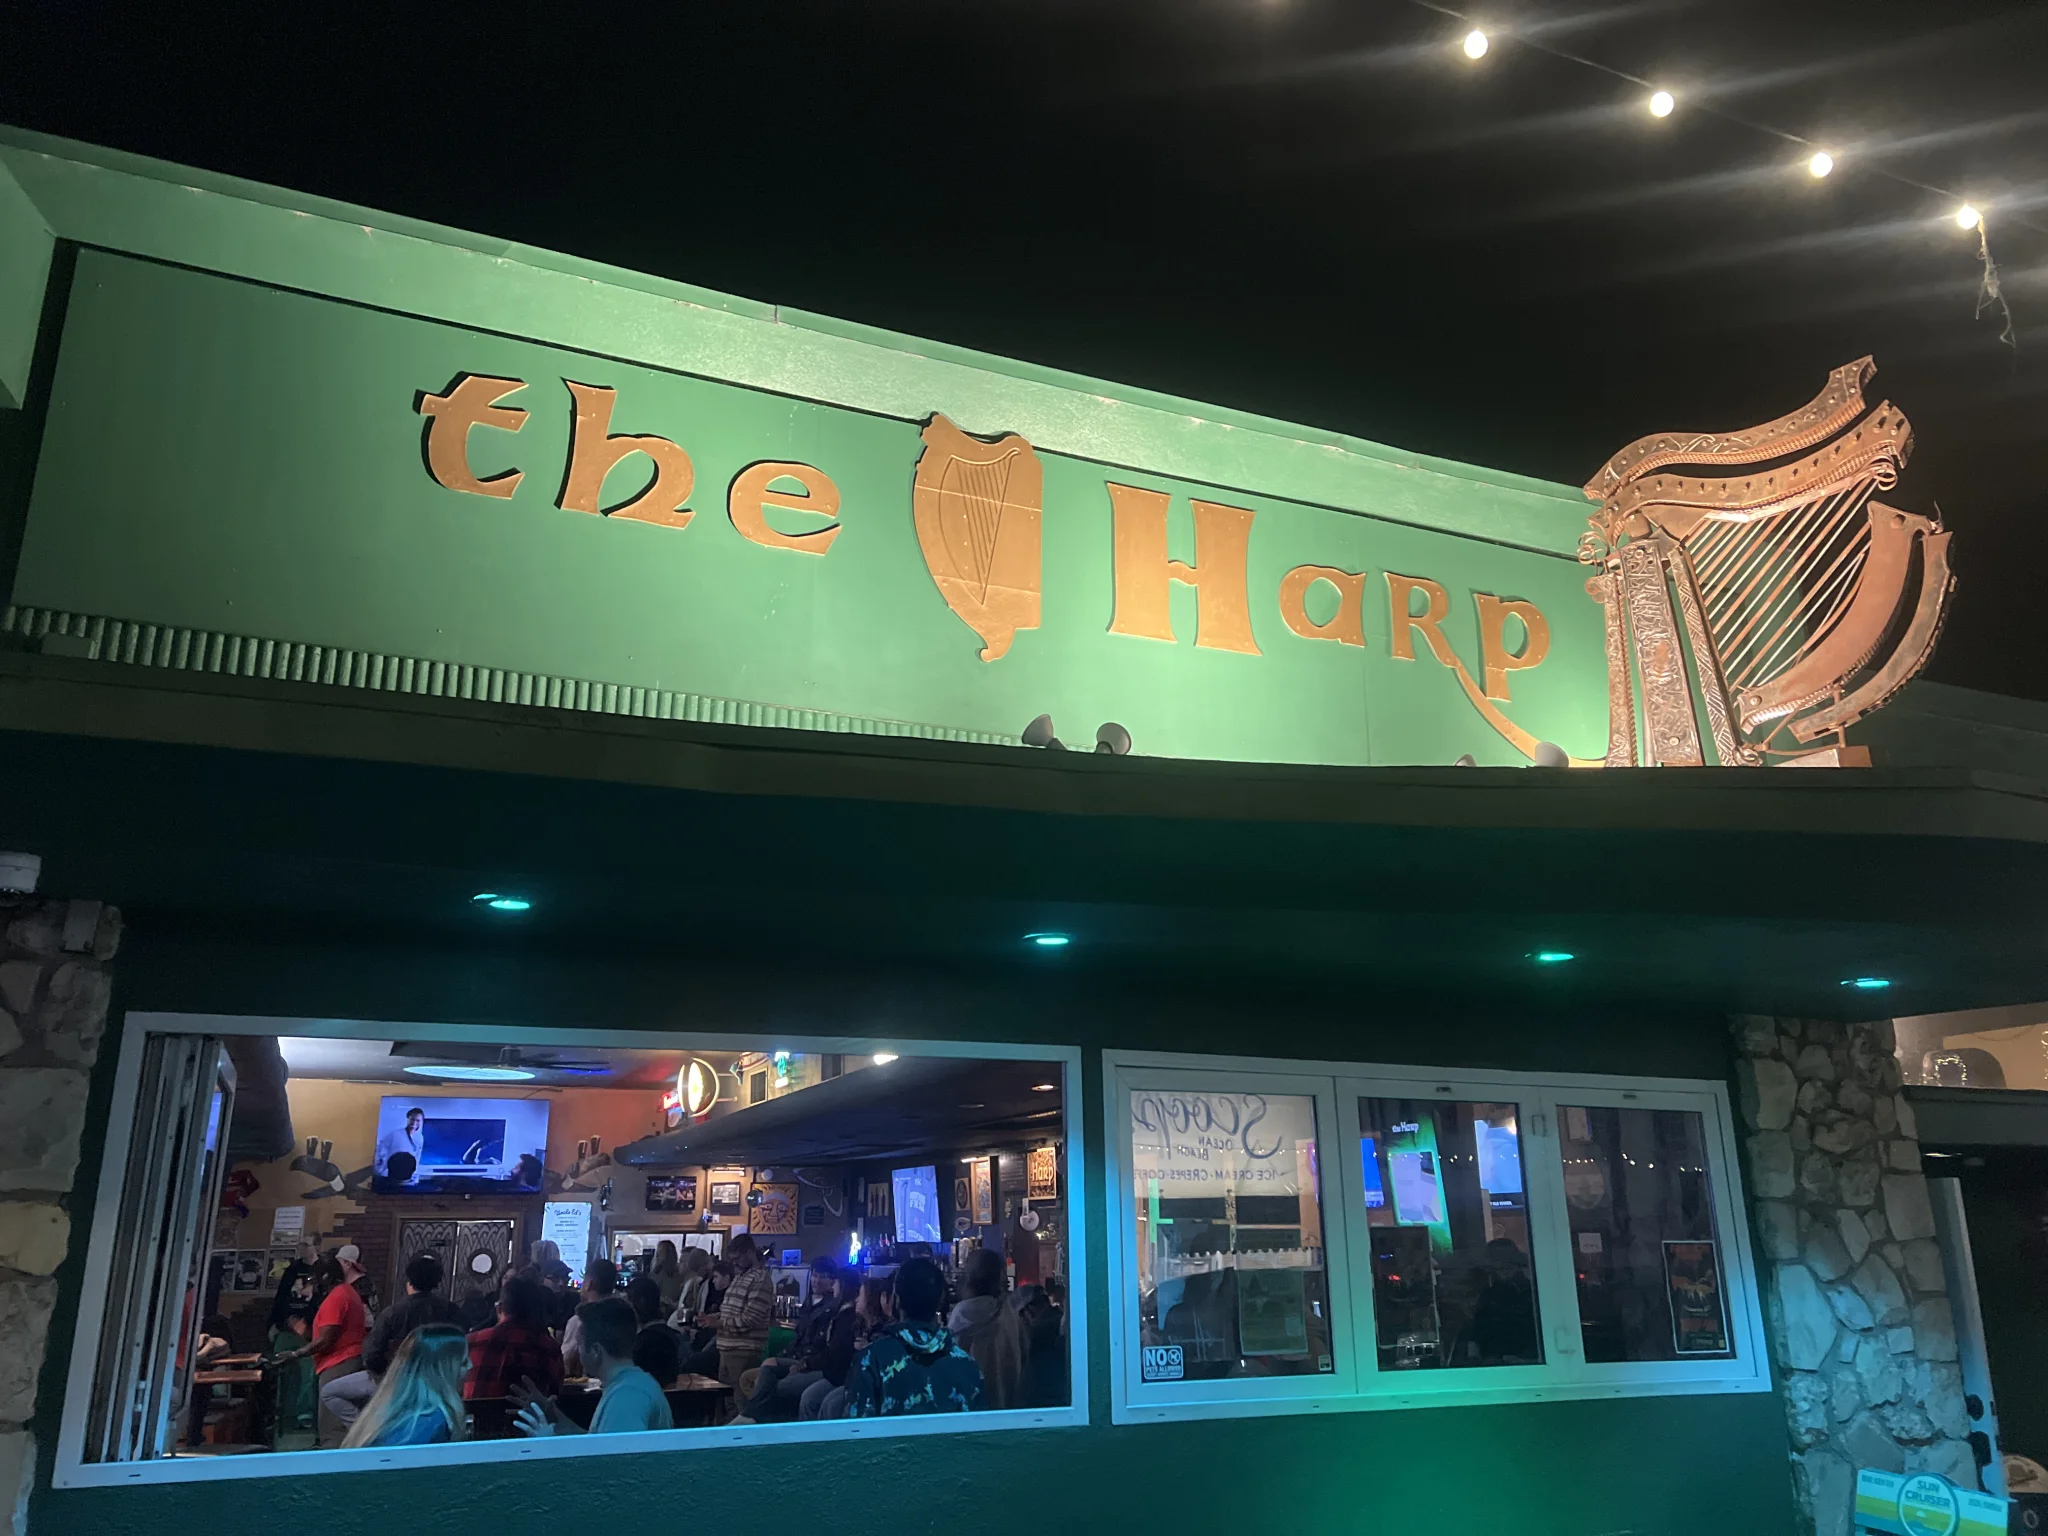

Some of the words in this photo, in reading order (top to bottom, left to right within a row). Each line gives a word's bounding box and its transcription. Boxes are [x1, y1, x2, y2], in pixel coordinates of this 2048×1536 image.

[415, 373, 842, 556] the
[1145, 1349, 1167, 1367] NO
[1916, 1479, 1940, 1493] SUN
[1904, 1489, 1951, 1508] CRUISER
